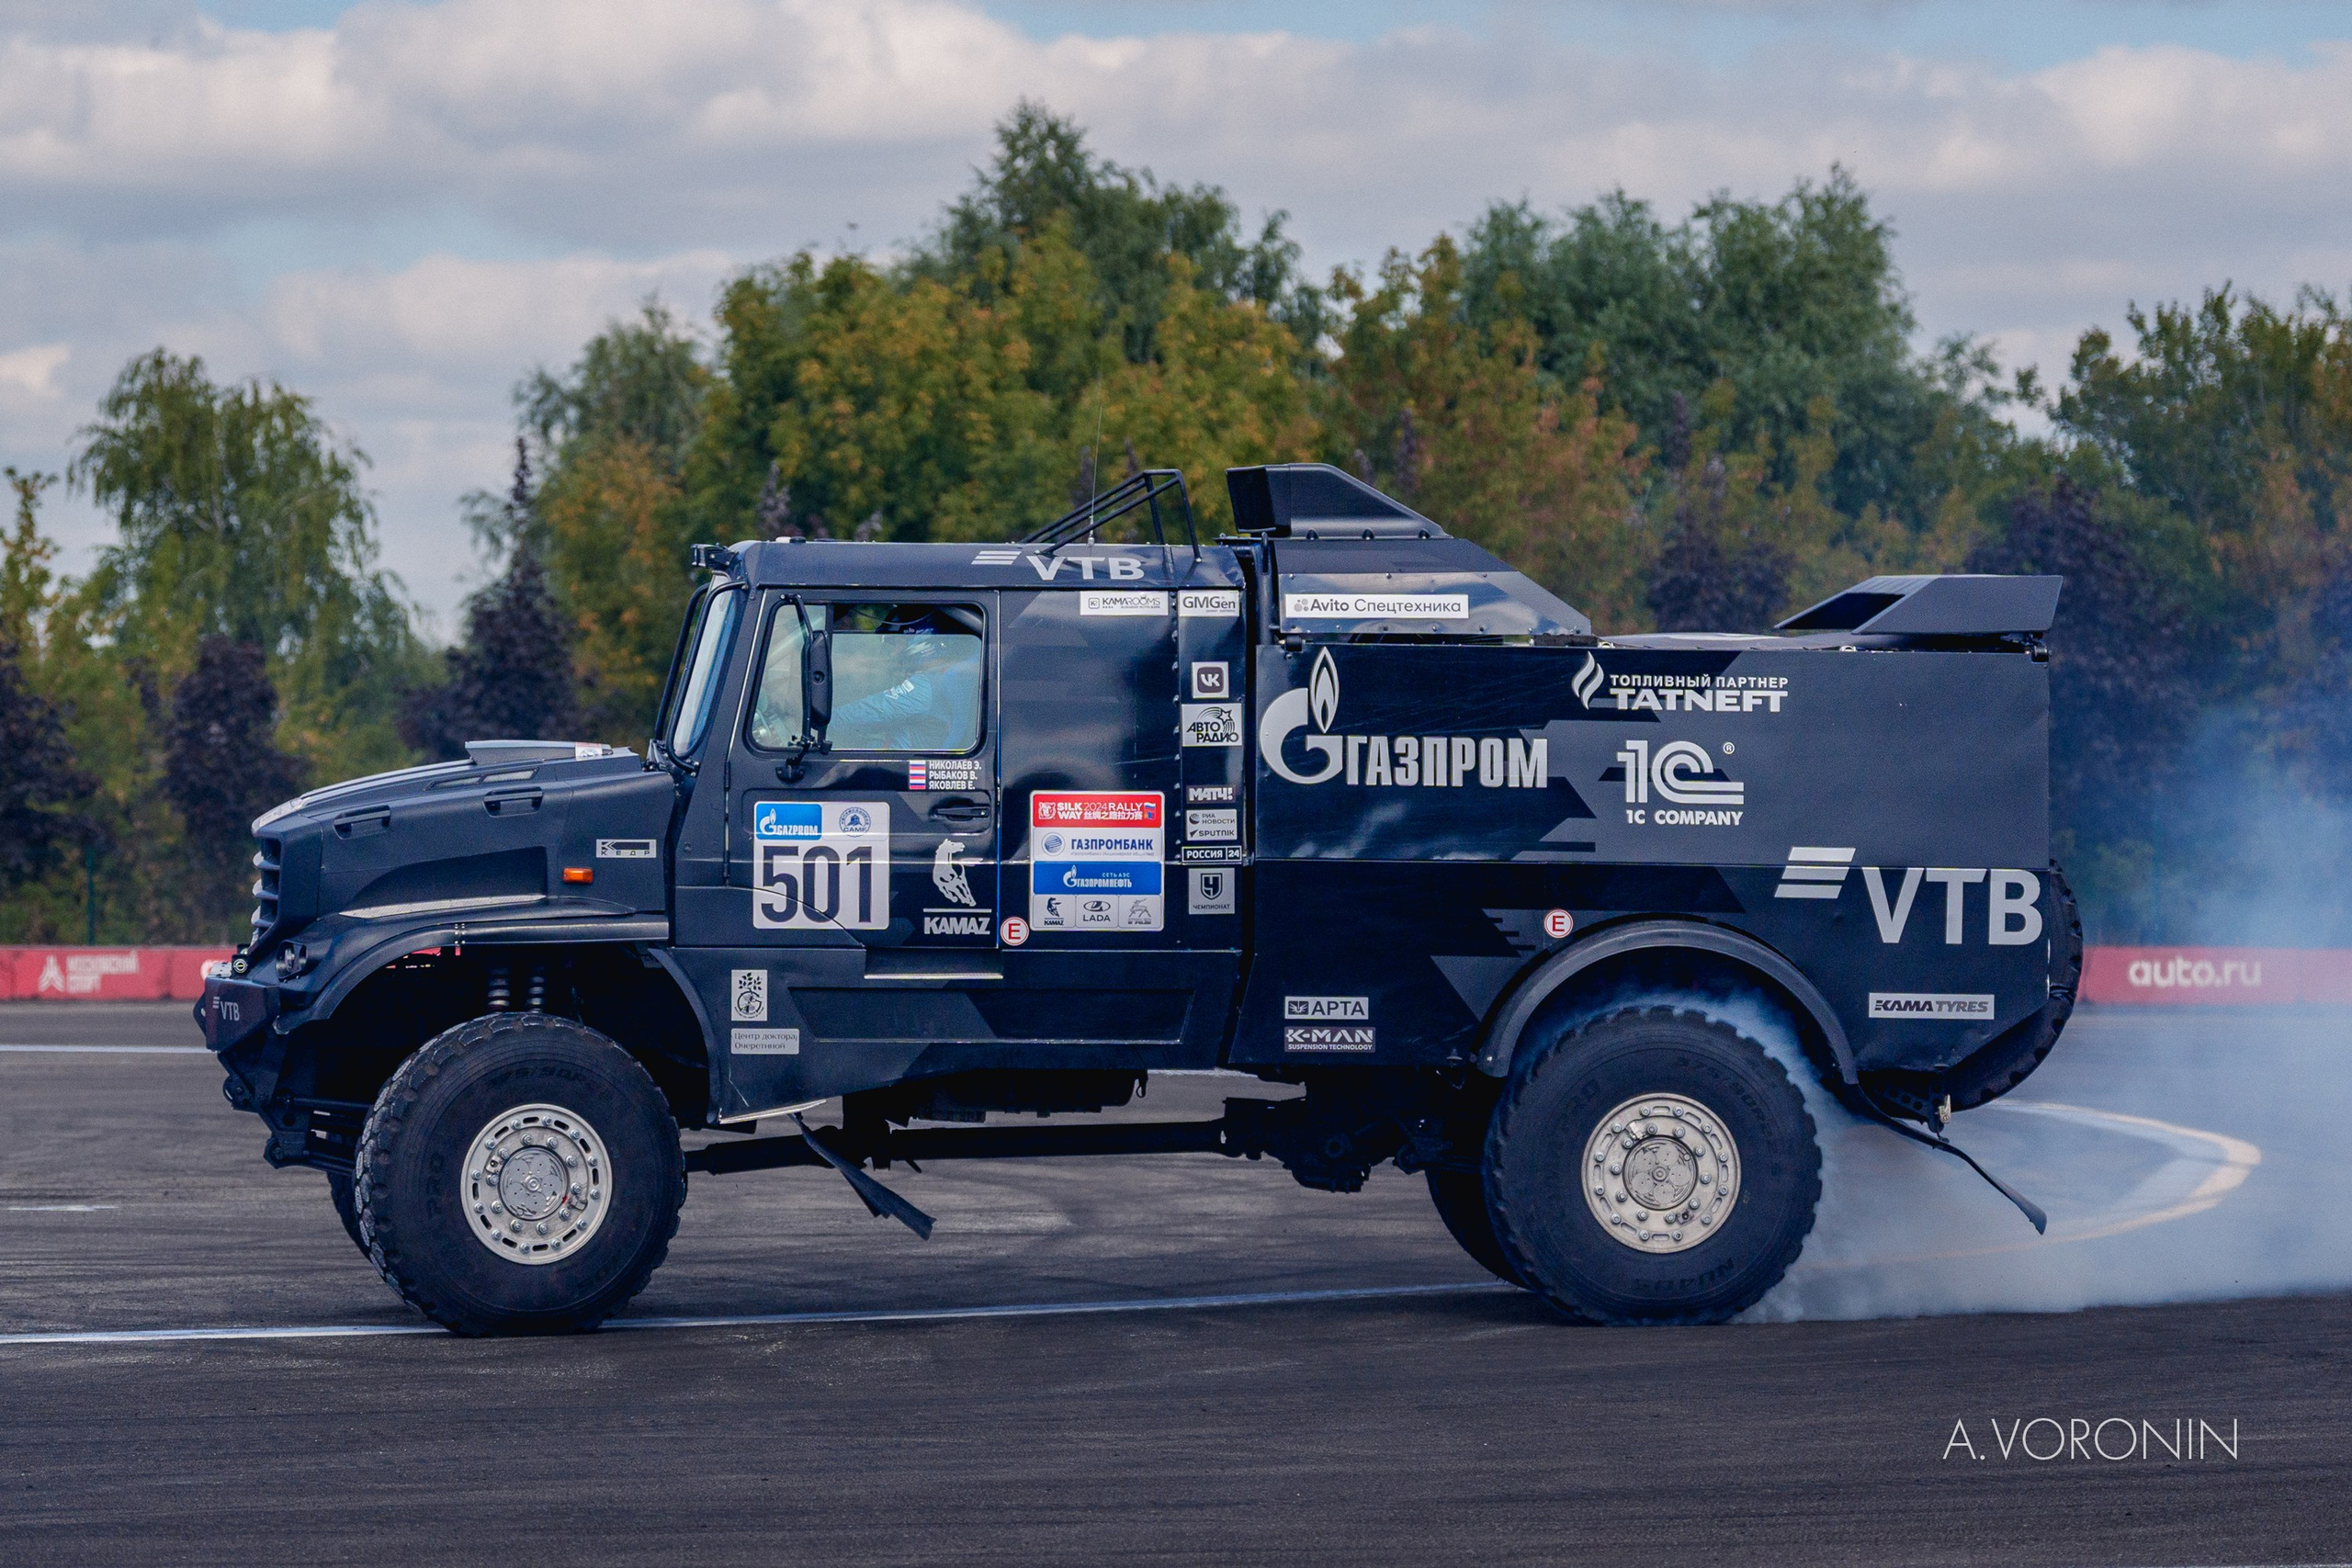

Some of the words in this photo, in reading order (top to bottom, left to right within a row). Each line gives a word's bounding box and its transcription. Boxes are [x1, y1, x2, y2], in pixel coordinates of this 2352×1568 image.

[1025, 556, 1145, 581] VTB
[1102, 596, 1160, 606] KAMAROOMS
[1183, 596, 1236, 608] GMGen
[1310, 598, 1350, 612] Avito
[1354, 598, 1462, 615] Спецтехника
[1201, 673, 1220, 687] VK
[1610, 674, 1711, 688] ТОПЛИВНЫЙ
[1715, 677, 1789, 689] ПАРТНЕР
[1610, 689, 1789, 713] TATNEFT
[1186, 721, 1221, 733] АВТО
[1196, 732, 1238, 743] РАДИО
[929, 760, 973, 770] НИКОЛАЕВ
[974, 760, 982, 770] Э.
[1347, 736, 1548, 788] ГАЗПРОМ
[929, 770, 968, 780] РЫБАКОВ
[969, 770, 978, 780] В.
[1617, 739, 1745, 805] 1C
[929, 780, 967, 790] ЯКОВЛЕВ
[967, 780, 976, 790] Е.
[1189, 787, 1233, 801] МАТЧ!
[1057, 802, 1082, 811] SILK
[1084, 802, 1107, 811] 2024
[1108, 802, 1142, 811] RALLY
[1057, 811, 1082, 820] WAY
[1626, 809, 1645, 825] 1C
[1655, 809, 1744, 826] COMPANY
[775, 825, 819, 836] GAZPROM
[1071, 839, 1153, 851] ГАЗПРОМБАНК
[1186, 850, 1223, 859] РОССИЯ
[1227, 850, 1239, 858] 24
[761, 845, 873, 923] 501
[1077, 878, 1133, 888] ГАЗПРОМНЕФТЬ
[1861, 866, 2043, 945] VTB
[924, 917, 990, 935] KAMAZ
[1552, 915, 1565, 931] E
[1008, 923, 1021, 940] E
[2129, 955, 2262, 987] auto.ru
[220, 1001, 240, 1021] VTB
[1875, 999, 1934, 1011] KAMA
[1935, 1000, 1989, 1013] TYRES
[734, 1032, 761, 1041] Центр
[1285, 1029, 1373, 1043] K-MAN
